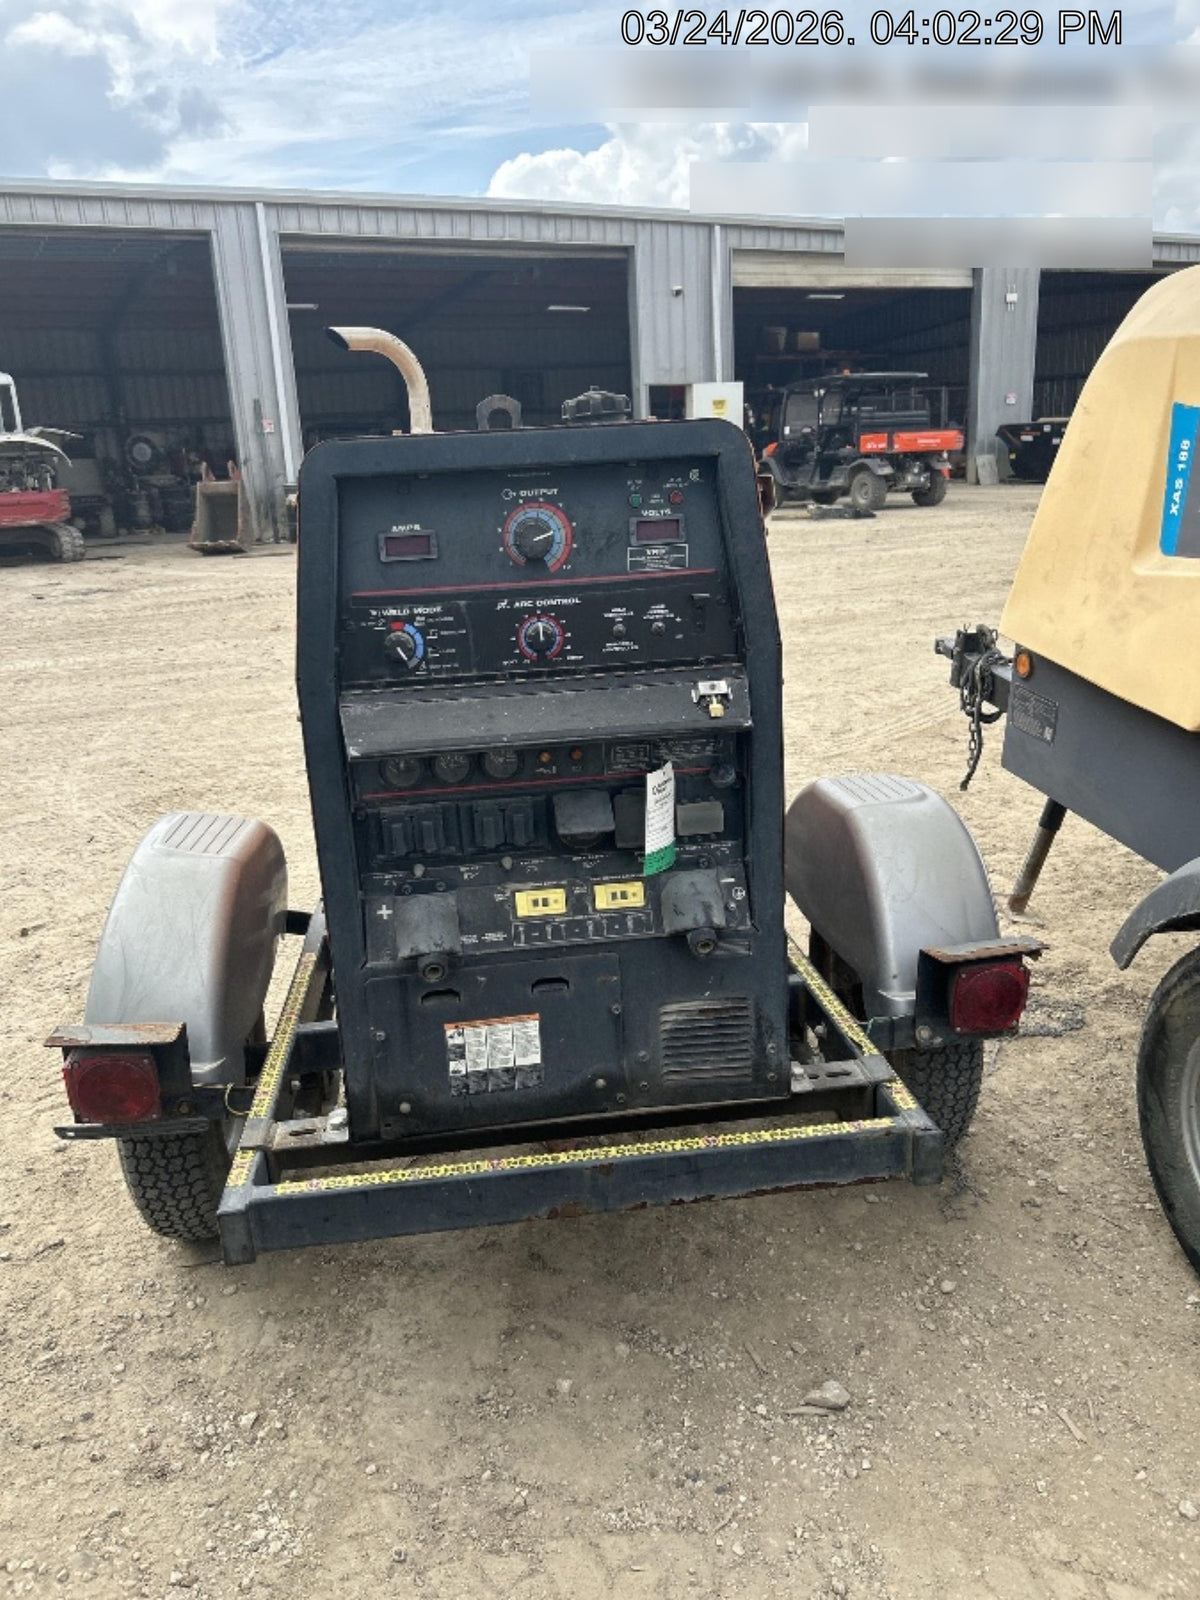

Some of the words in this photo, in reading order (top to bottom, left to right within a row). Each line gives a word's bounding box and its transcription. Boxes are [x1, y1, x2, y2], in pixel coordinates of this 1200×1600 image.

[519, 488, 559, 497] OUTPUT
[1169, 478, 1184, 516] XAS
[641, 508, 672, 517] VOLTS
[513, 600, 534, 609] ARC
[536, 597, 582, 607] CONTROL
